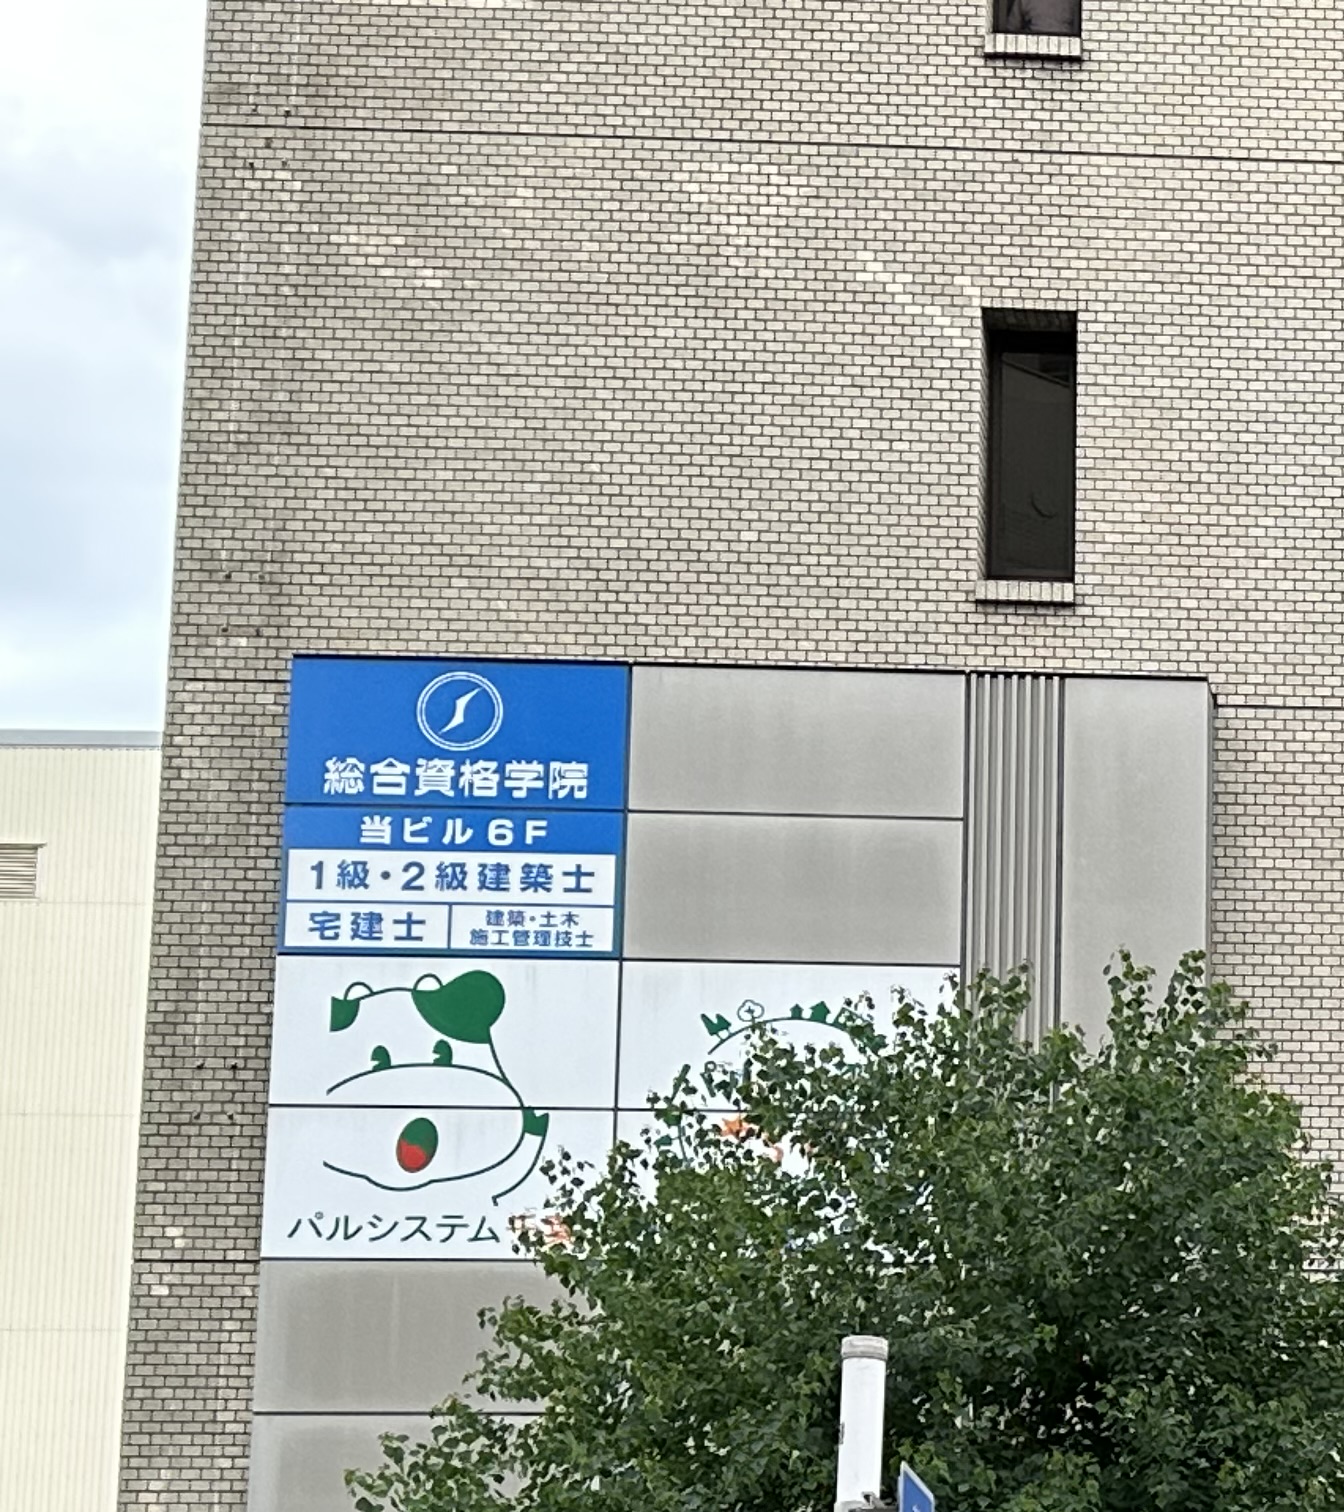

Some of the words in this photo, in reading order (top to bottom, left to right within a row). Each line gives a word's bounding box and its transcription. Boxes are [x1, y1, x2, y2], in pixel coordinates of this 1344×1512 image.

[322, 756, 590, 800] 総合資格学院
[309, 860, 597, 893] 1級・2級建築士
[307, 910, 427, 943] 宅建士
[469, 928, 595, 948] 施工管理技士
[287, 1211, 501, 1246] パルシステム
